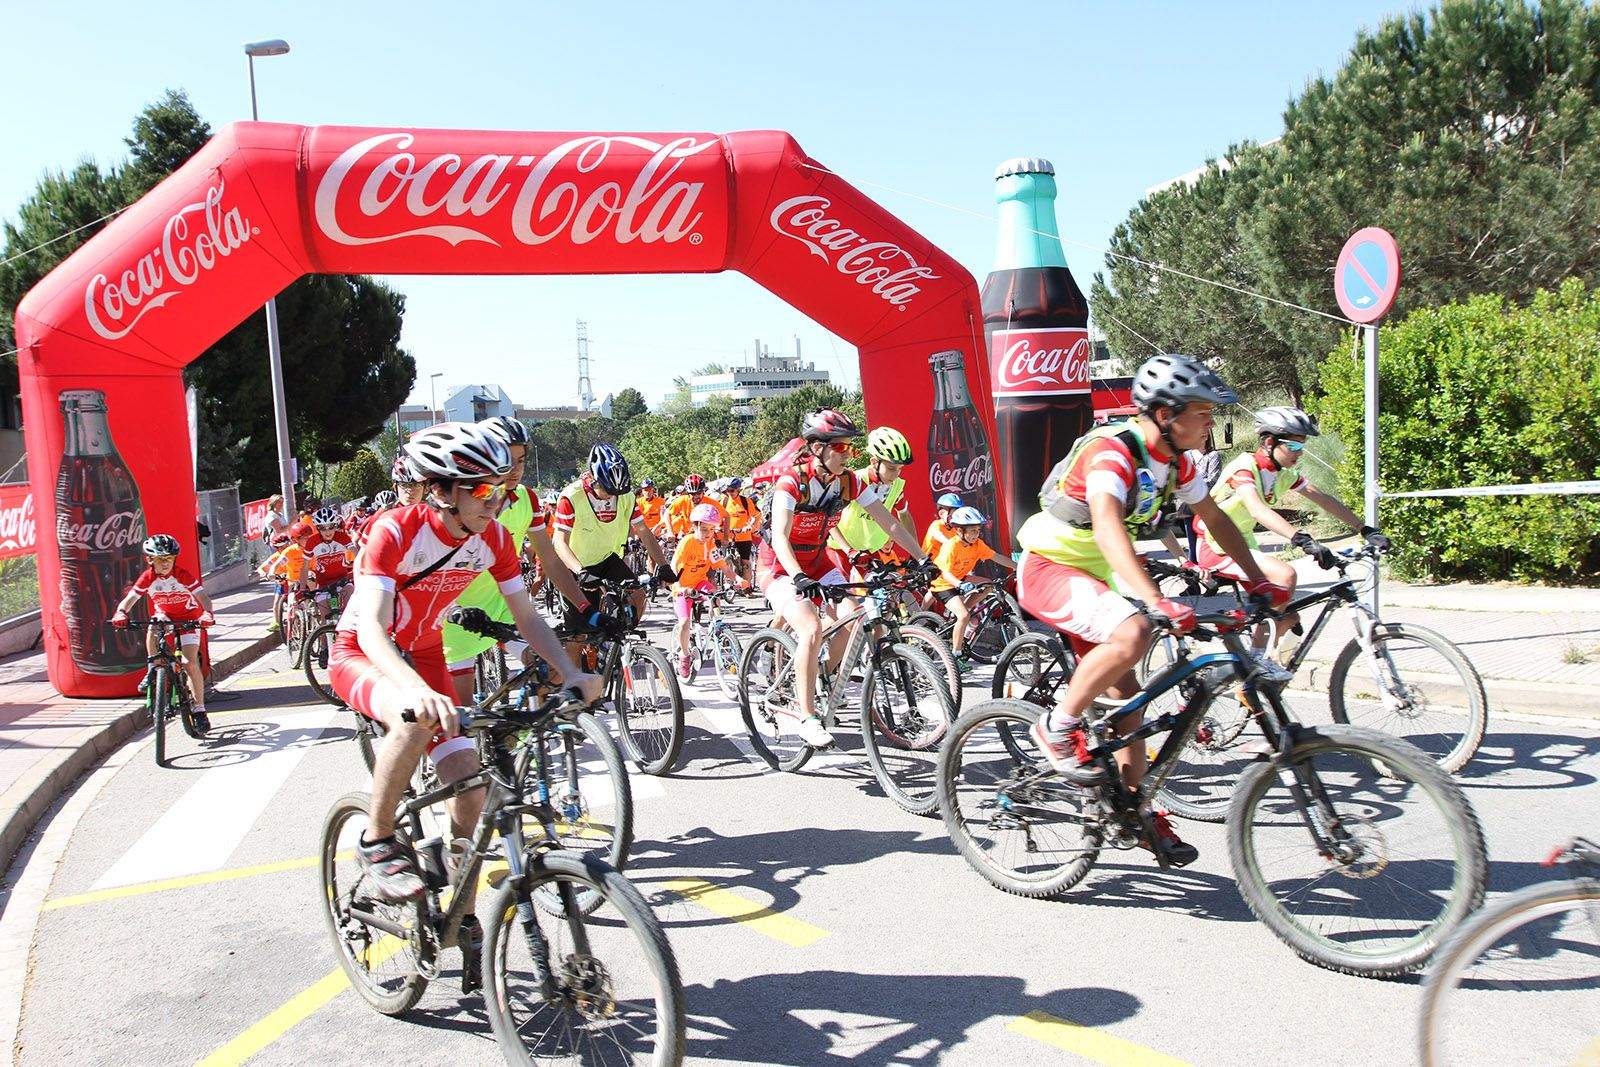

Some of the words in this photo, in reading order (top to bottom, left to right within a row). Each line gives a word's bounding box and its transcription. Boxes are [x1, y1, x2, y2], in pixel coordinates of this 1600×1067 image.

[315, 133, 721, 247] Coca-Cola
[85, 170, 250, 340] Coca-Cola
[770, 195, 942, 306] Coca-Cola
[998, 338, 1090, 387] Coca-Co
[441, 583, 466, 592] CUG
